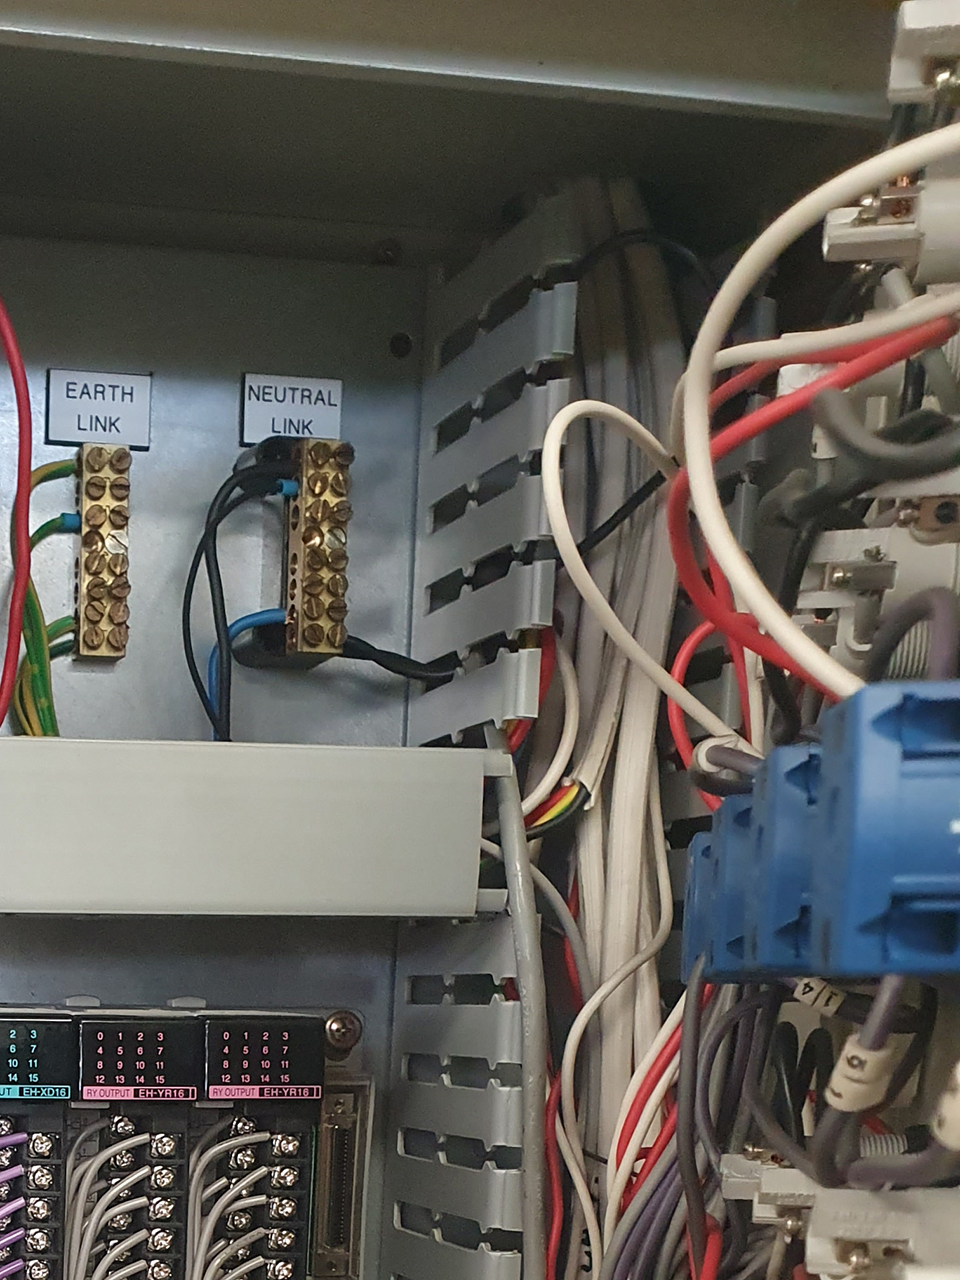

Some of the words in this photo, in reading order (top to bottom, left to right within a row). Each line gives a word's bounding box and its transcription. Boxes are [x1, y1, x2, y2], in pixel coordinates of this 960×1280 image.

[66, 381, 134, 402] EARTH
[248, 384, 338, 407] NEUTRAL
[77, 414, 121, 433] LINK
[271, 417, 313, 435] LINK
[9, 1029, 16, 1038] 2
[30, 1029, 37, 1038] 3
[97, 1032, 103, 1041] 0
[118, 1032, 122, 1041] 1
[137, 1032, 143, 1041] 2
[157, 1032, 164, 1041] 3
[223, 1032, 229, 1040] 0
[244, 1032, 248, 1040] 1
[262, 1032, 269, 1040] 2
[282, 1032, 289, 1040] 3
[9, 1044, 16, 1053] 6
[30, 1044, 37, 1053] 7
[97, 1047, 103, 1055] 4
[117, 1047, 124, 1055] 5
[137, 1047, 143, 1055] 6
[157, 1047, 163, 1055] 7
[223, 1046, 229, 1054] 4
[243, 1046, 249, 1054] 5
[262, 1046, 268, 1054] 6
[282, 1046, 288, 1054] 7
[8, 1058, 18, 1067] 10
[29, 1058, 38, 1067] 11
[97, 1061, 103, 1070] 8
[117, 1061, 123, 1070] 9
[135, 1061, 145, 1070] 10
[155, 1061, 164, 1070] 11
[223, 1060, 229, 1068] 8
[243, 1060, 249, 1068] 9
[261, 1060, 270, 1068] 10
[281, 1060, 289, 1068] 11
[8, 1073, 18, 1082] 14
[28, 1073, 39, 1082] 15
[95, 1075, 105, 1084] 12
[115, 1075, 125, 1084] 13
[135, 1075, 145, 1084] 14
[155, 1075, 165, 1084] 15
[221, 1074, 231, 1083] 12
[241, 1074, 250, 1083] 13
[260, 1074, 270, 1083] 14
[280, 1074, 289, 1083] 15
[23, 1087, 67, 1097] EH-XD16
[87, 1089, 97, 1097] RY
[99, 1089, 130, 1097] OUTPUT
[139, 1089, 184, 1098] EH-YR16
[212, 1088, 223, 1096] RY
[224, 1088, 255, 1096] OUTPUT
[264, 1088, 309, 1097] EH-YR16
